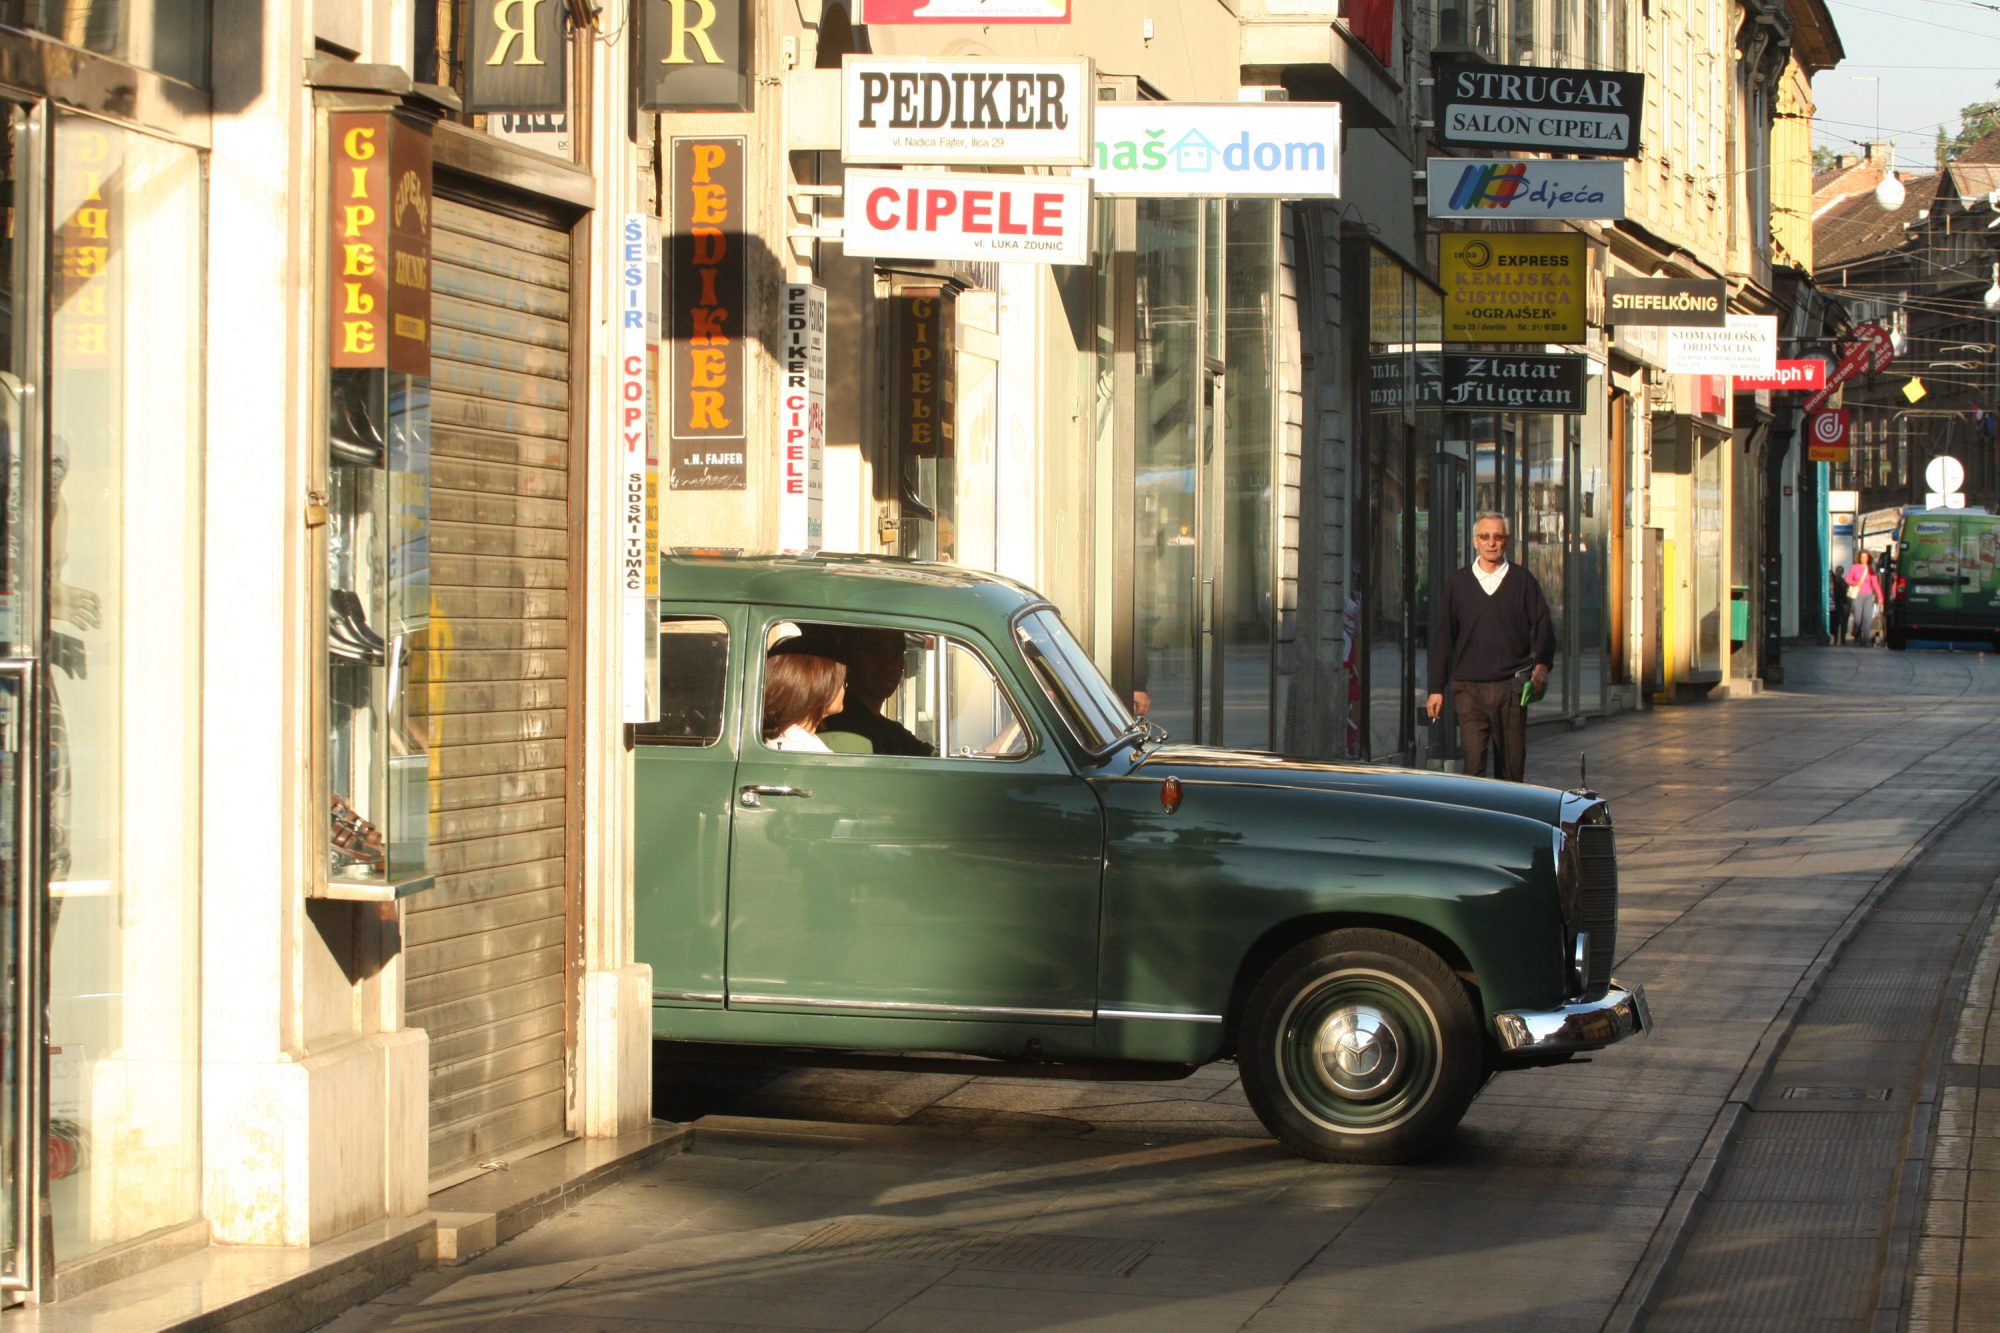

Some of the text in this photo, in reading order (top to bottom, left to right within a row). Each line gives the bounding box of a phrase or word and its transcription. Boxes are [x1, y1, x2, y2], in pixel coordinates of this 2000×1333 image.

[661, 0, 725, 64] R
[858, 71, 1069, 131] PEDIKER
[1456, 71, 1623, 108] STRUGAR
[905, 137, 936, 147] Nadica
[991, 137, 1004, 148] 29
[1453, 113, 1624, 141] SALON CIPELA
[1222, 130, 1326, 172] dom
[865, 186, 1065, 236] CIPELE
[343, 127, 377, 354] CIPELE
[991, 240, 1019, 249] LUKA
[1497, 255, 1570, 267] EXPRESS
[625, 218, 643, 328] ŠEŠIR
[689, 144, 731, 430] PEDIKER
[1454, 271, 1573, 287] KEMIJSKA
[1454, 287, 1572, 305] ČISTIONICA
[788, 288, 808, 388] PEDIKER
[911, 297, 932, 444] CIPELE
[1464, 357, 1561, 379] Zlatar
[1740, 366, 1801, 385] umph
[624, 356, 642, 452] COPY
[1445, 381, 1572, 407] Filigran
[705, 452, 743, 465] FAJFER
[786, 395, 806, 495] CIPELE
[628, 473, 642, 534] SUDSKI
[626, 538, 643, 590] TUMAČ
